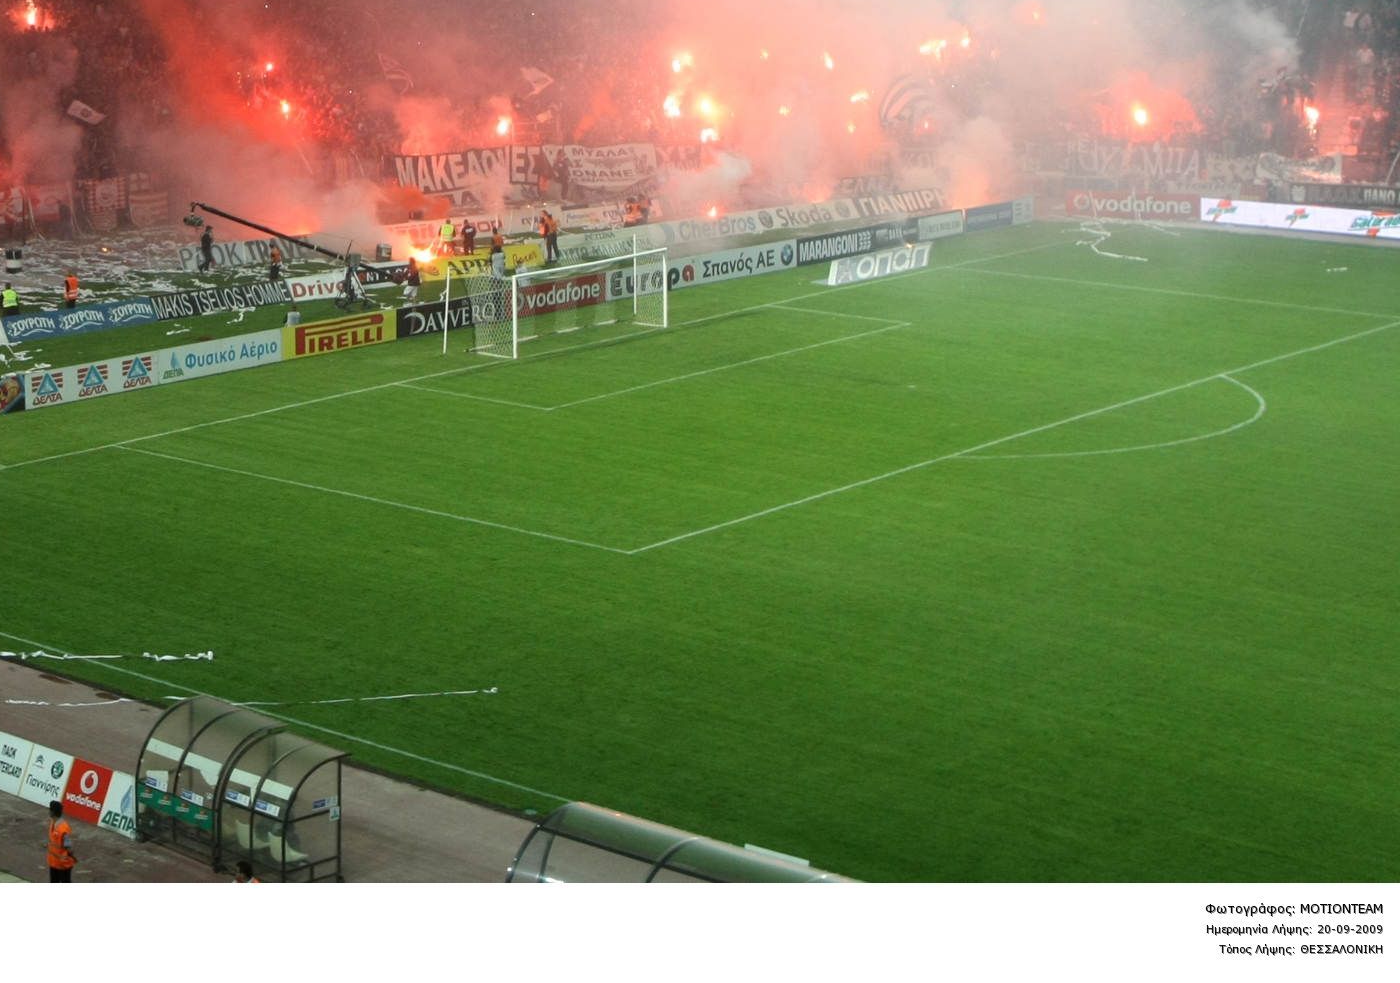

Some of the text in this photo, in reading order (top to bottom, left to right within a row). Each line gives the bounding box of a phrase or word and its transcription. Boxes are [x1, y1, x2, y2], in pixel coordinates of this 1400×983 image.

[776, 205, 832, 227] Skoda
[1094, 193, 1192, 214] vodafone
[799, 231, 858, 261] MARANGONI
[703, 250, 775, 278] Σπανός ΑΕ
[151, 280, 291, 320] MAKIS TSELIOS HOMME
[527, 280, 601, 310] vodafone
[11, 316, 54, 336] ΣΟΥΡΩΤΗ
[62, 310, 104, 329] ΣΟΥΡΩΤΗ
[294, 314, 384, 355] PIRELLI
[185, 341, 278, 369] Φυσικό Αέριο
[65, 791, 102, 812] vodafone
[101, 809, 138, 832] ΔΕΠΑ
